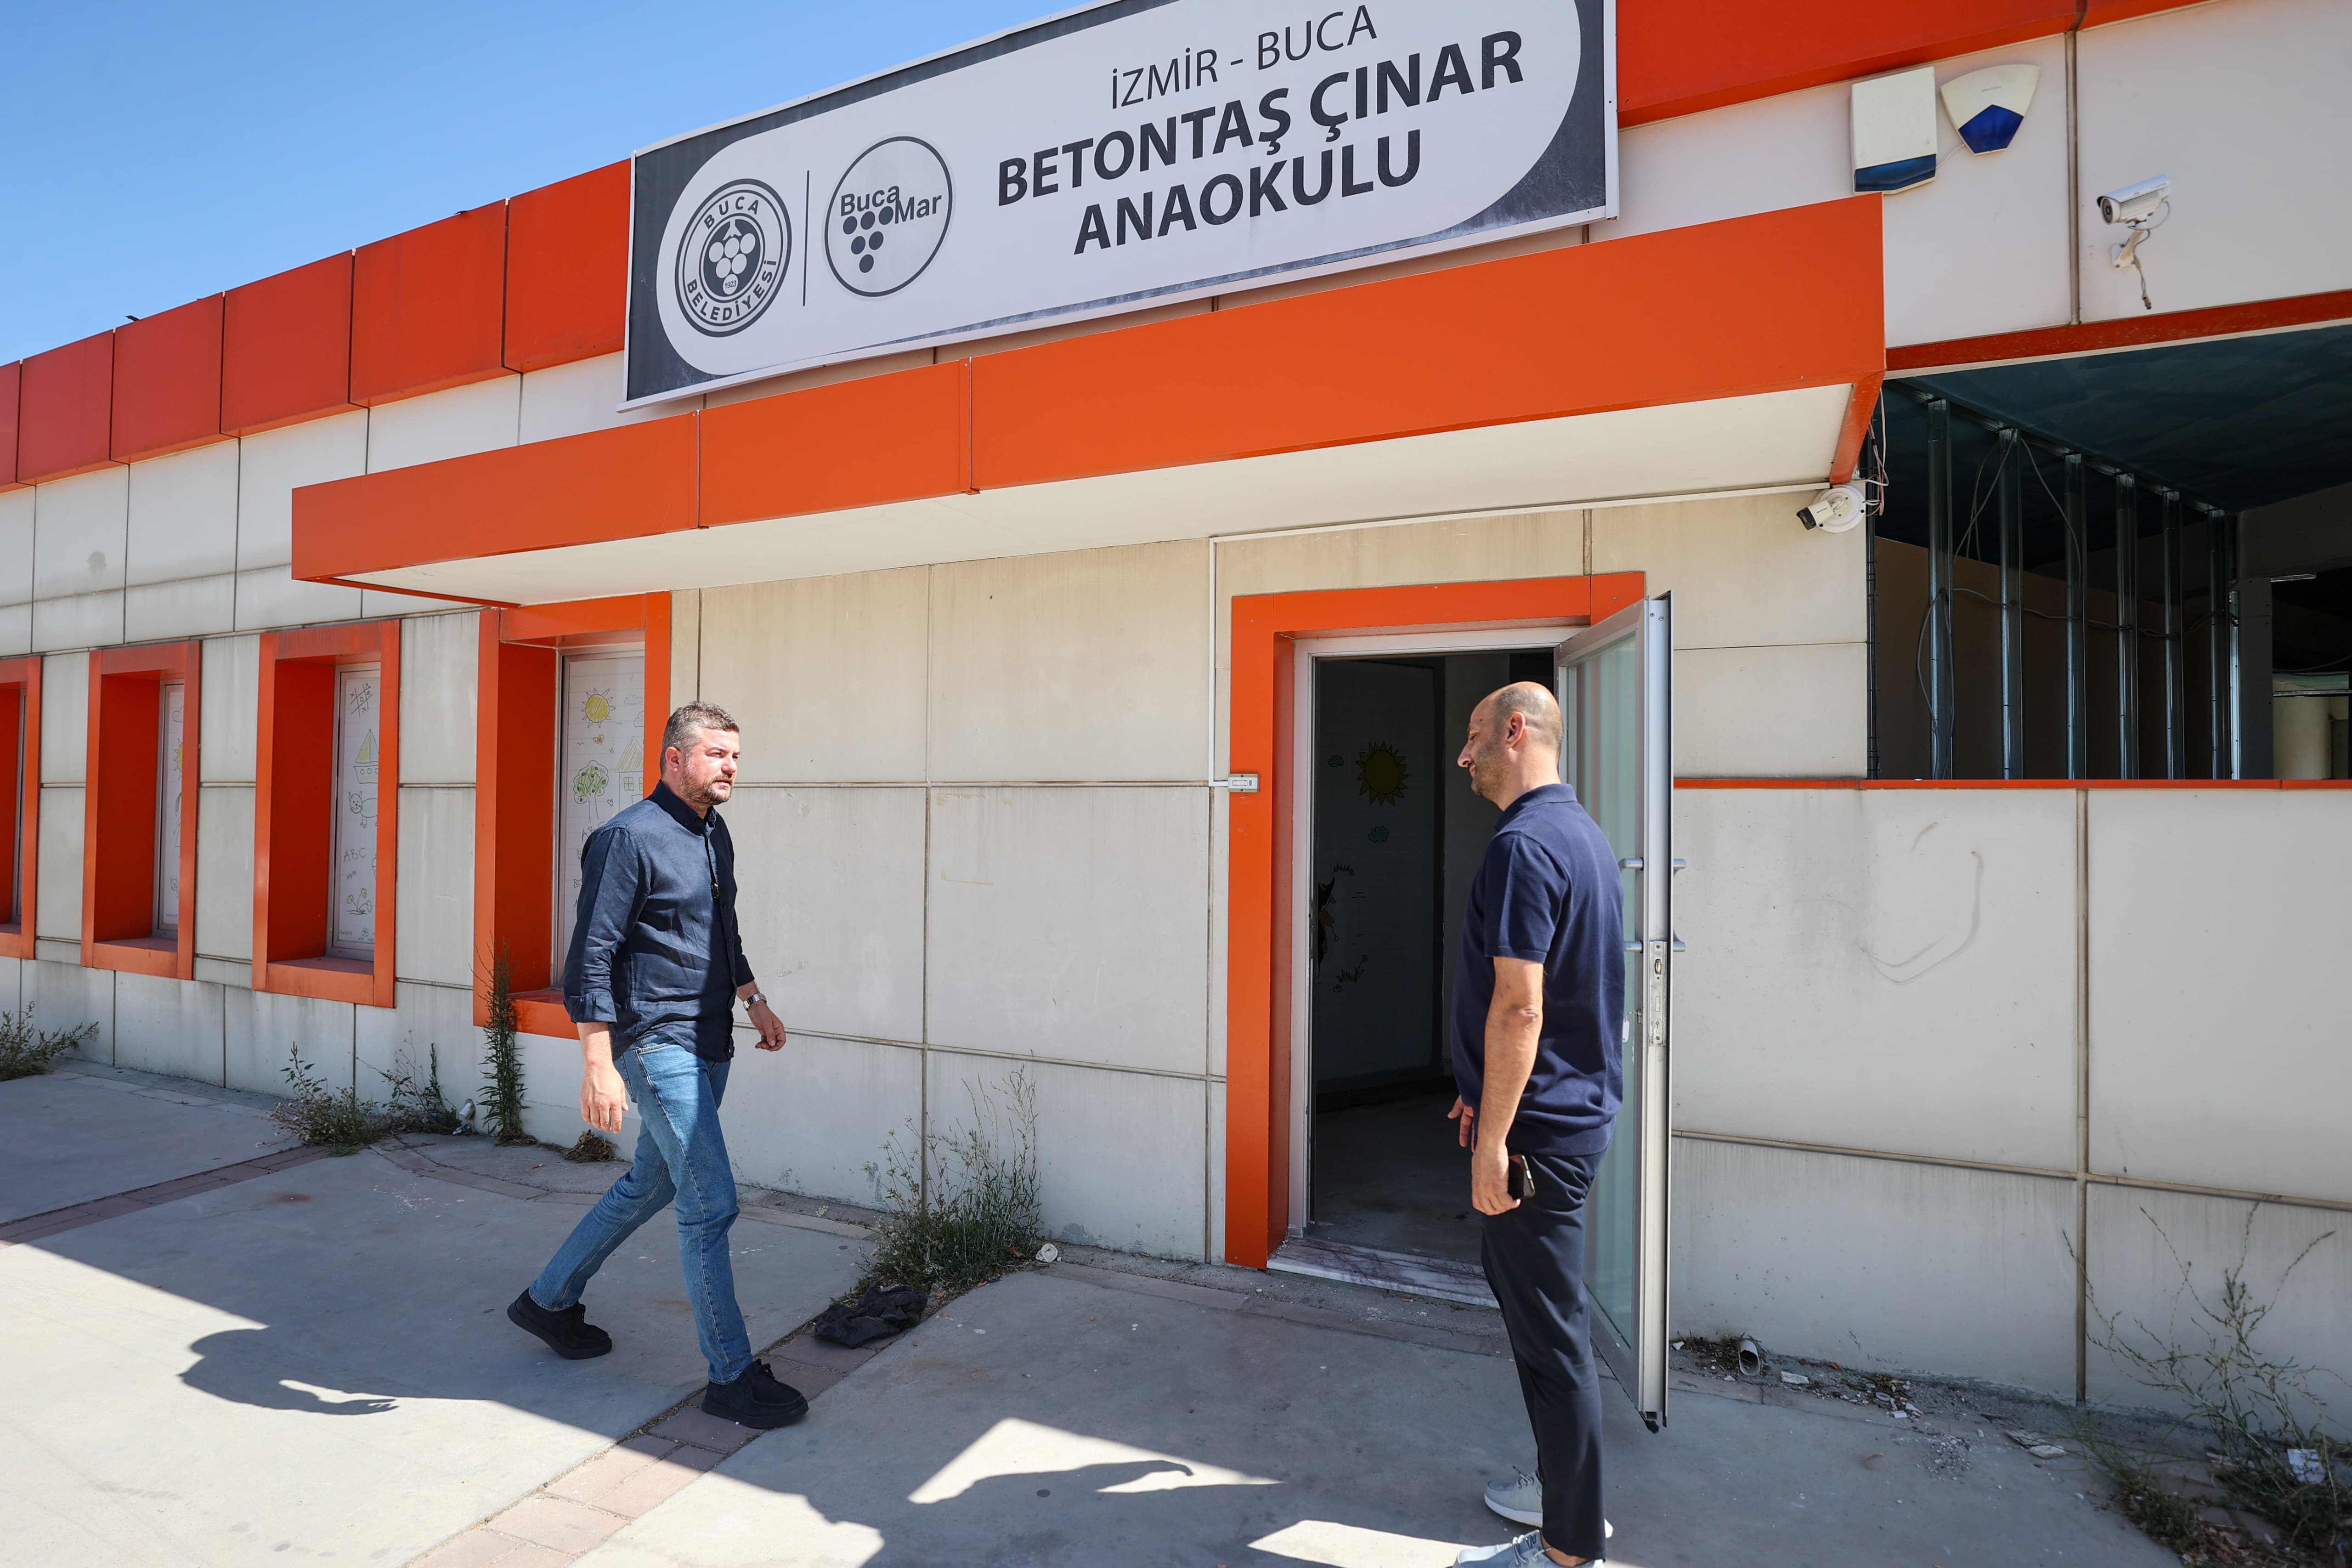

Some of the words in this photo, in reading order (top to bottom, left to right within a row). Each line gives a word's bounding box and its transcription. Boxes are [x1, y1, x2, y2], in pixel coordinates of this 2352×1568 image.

[1112, 47, 1218, 109] İZMİR
[1258, 5, 1377, 70] BUCA
[998, 88, 1291, 206] BETONTAŞ
[1310, 31, 1524, 142] ÇINAR
[841, 186, 899, 216] Buca
[1074, 129, 1420, 255] ANAOKULU
[704, 196, 759, 230] BUCA
[894, 195, 942, 224] Mar
[687, 260, 777, 321] BELEDİYESİ
[724, 280, 736, 289] 1923
[343, 847, 366, 862] ABC
